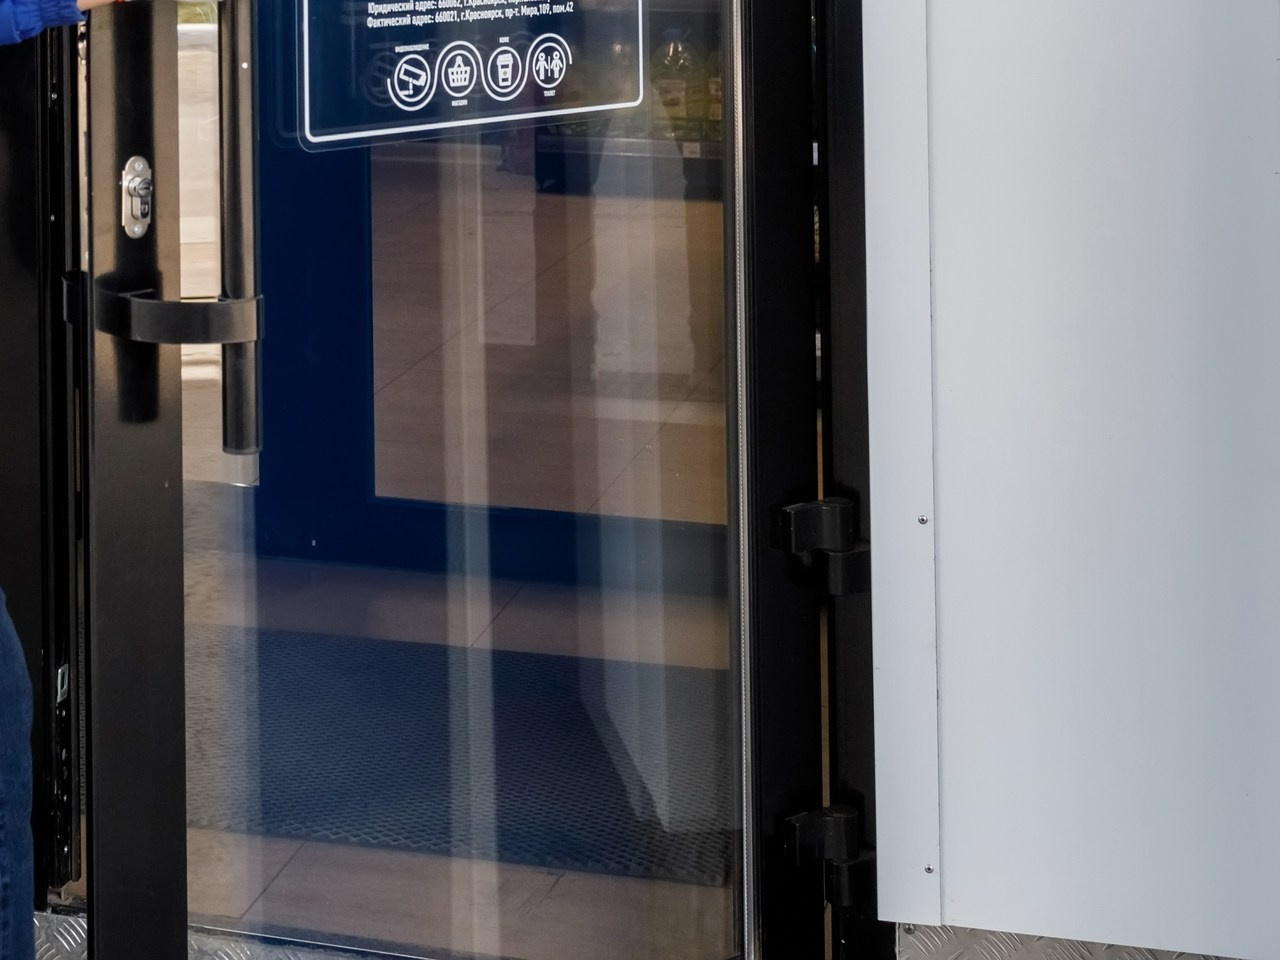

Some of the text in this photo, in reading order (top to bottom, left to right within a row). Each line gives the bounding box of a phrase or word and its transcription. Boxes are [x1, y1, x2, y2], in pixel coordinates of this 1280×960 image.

[367, 0, 414, 16] Юридический
[415, 0, 437, 12] адрес:
[366, 14, 411, 28] Фактический
[412, 14, 434, 26] адрес:
